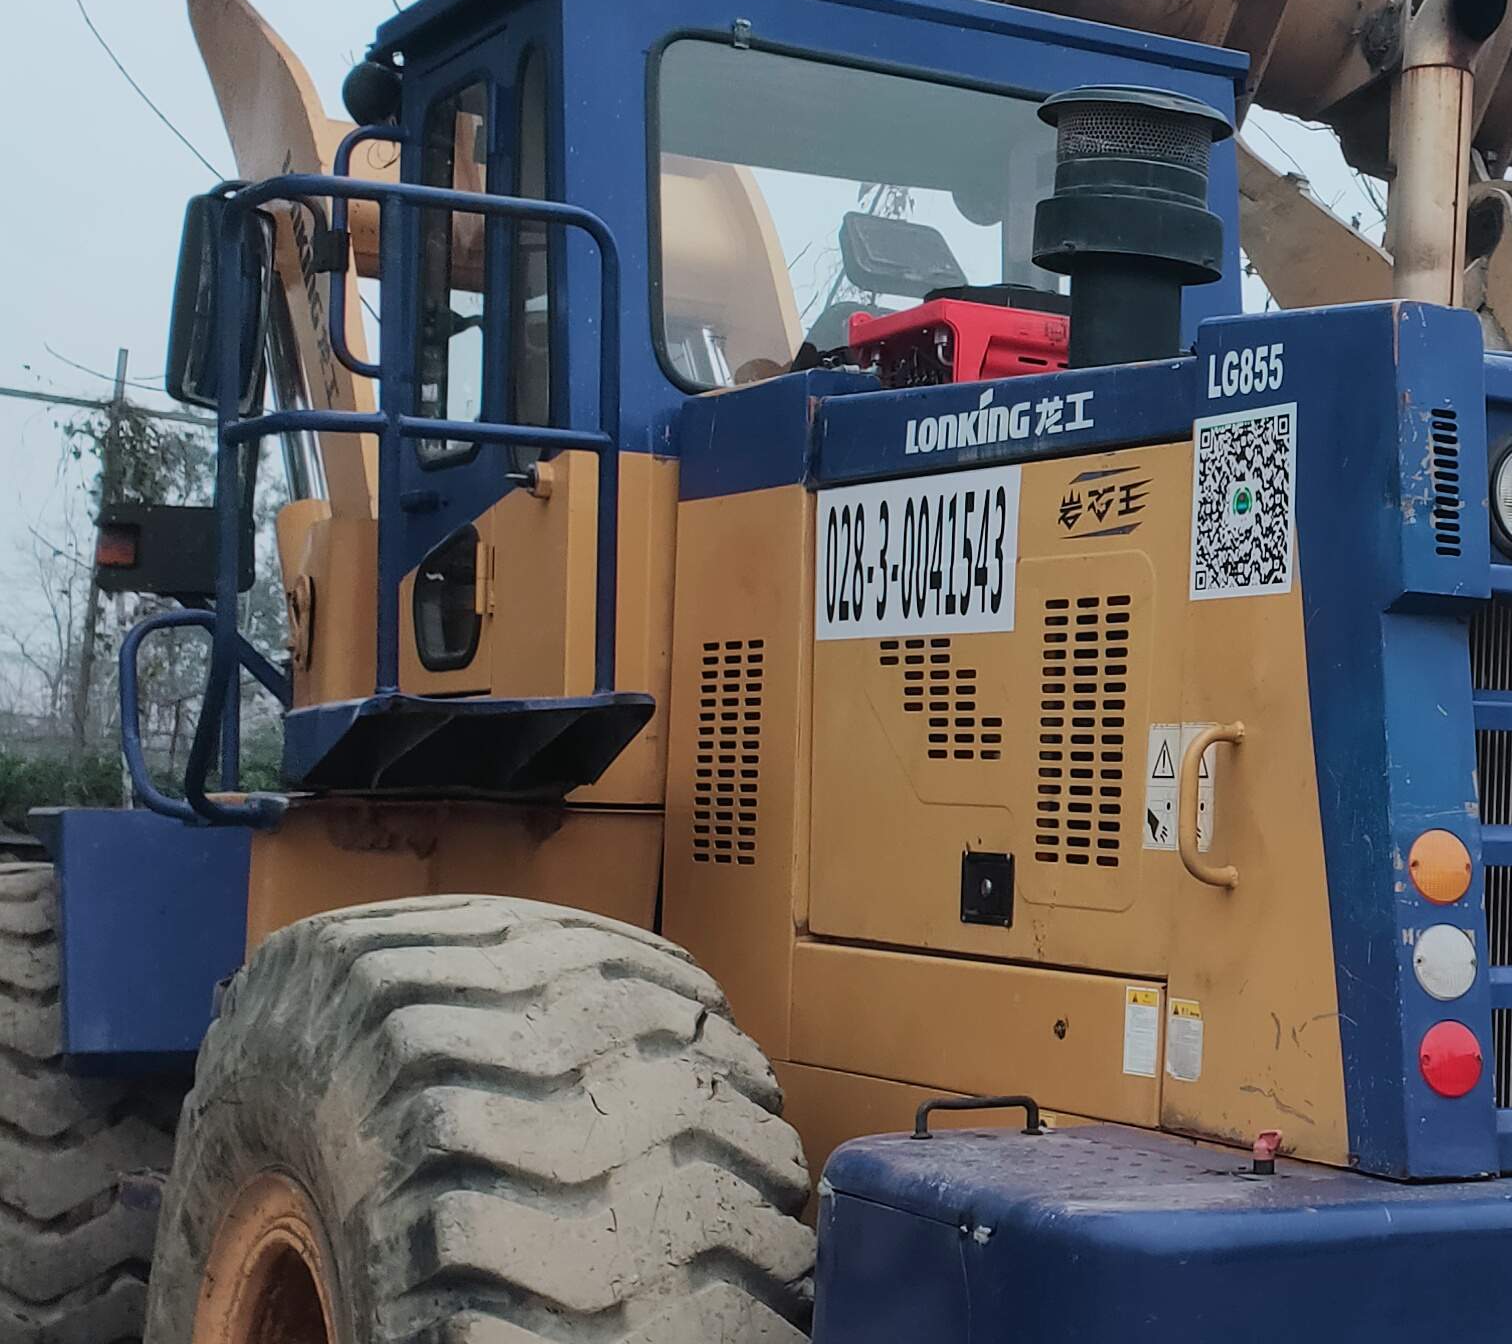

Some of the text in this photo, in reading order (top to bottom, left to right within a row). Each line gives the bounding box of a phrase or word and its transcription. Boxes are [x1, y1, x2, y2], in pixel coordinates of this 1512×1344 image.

[1207, 343, 1285, 399] LG855
[1034, 390, 1094, 437] 龙工
[826, 485, 1006, 624] 028-3-0041543
